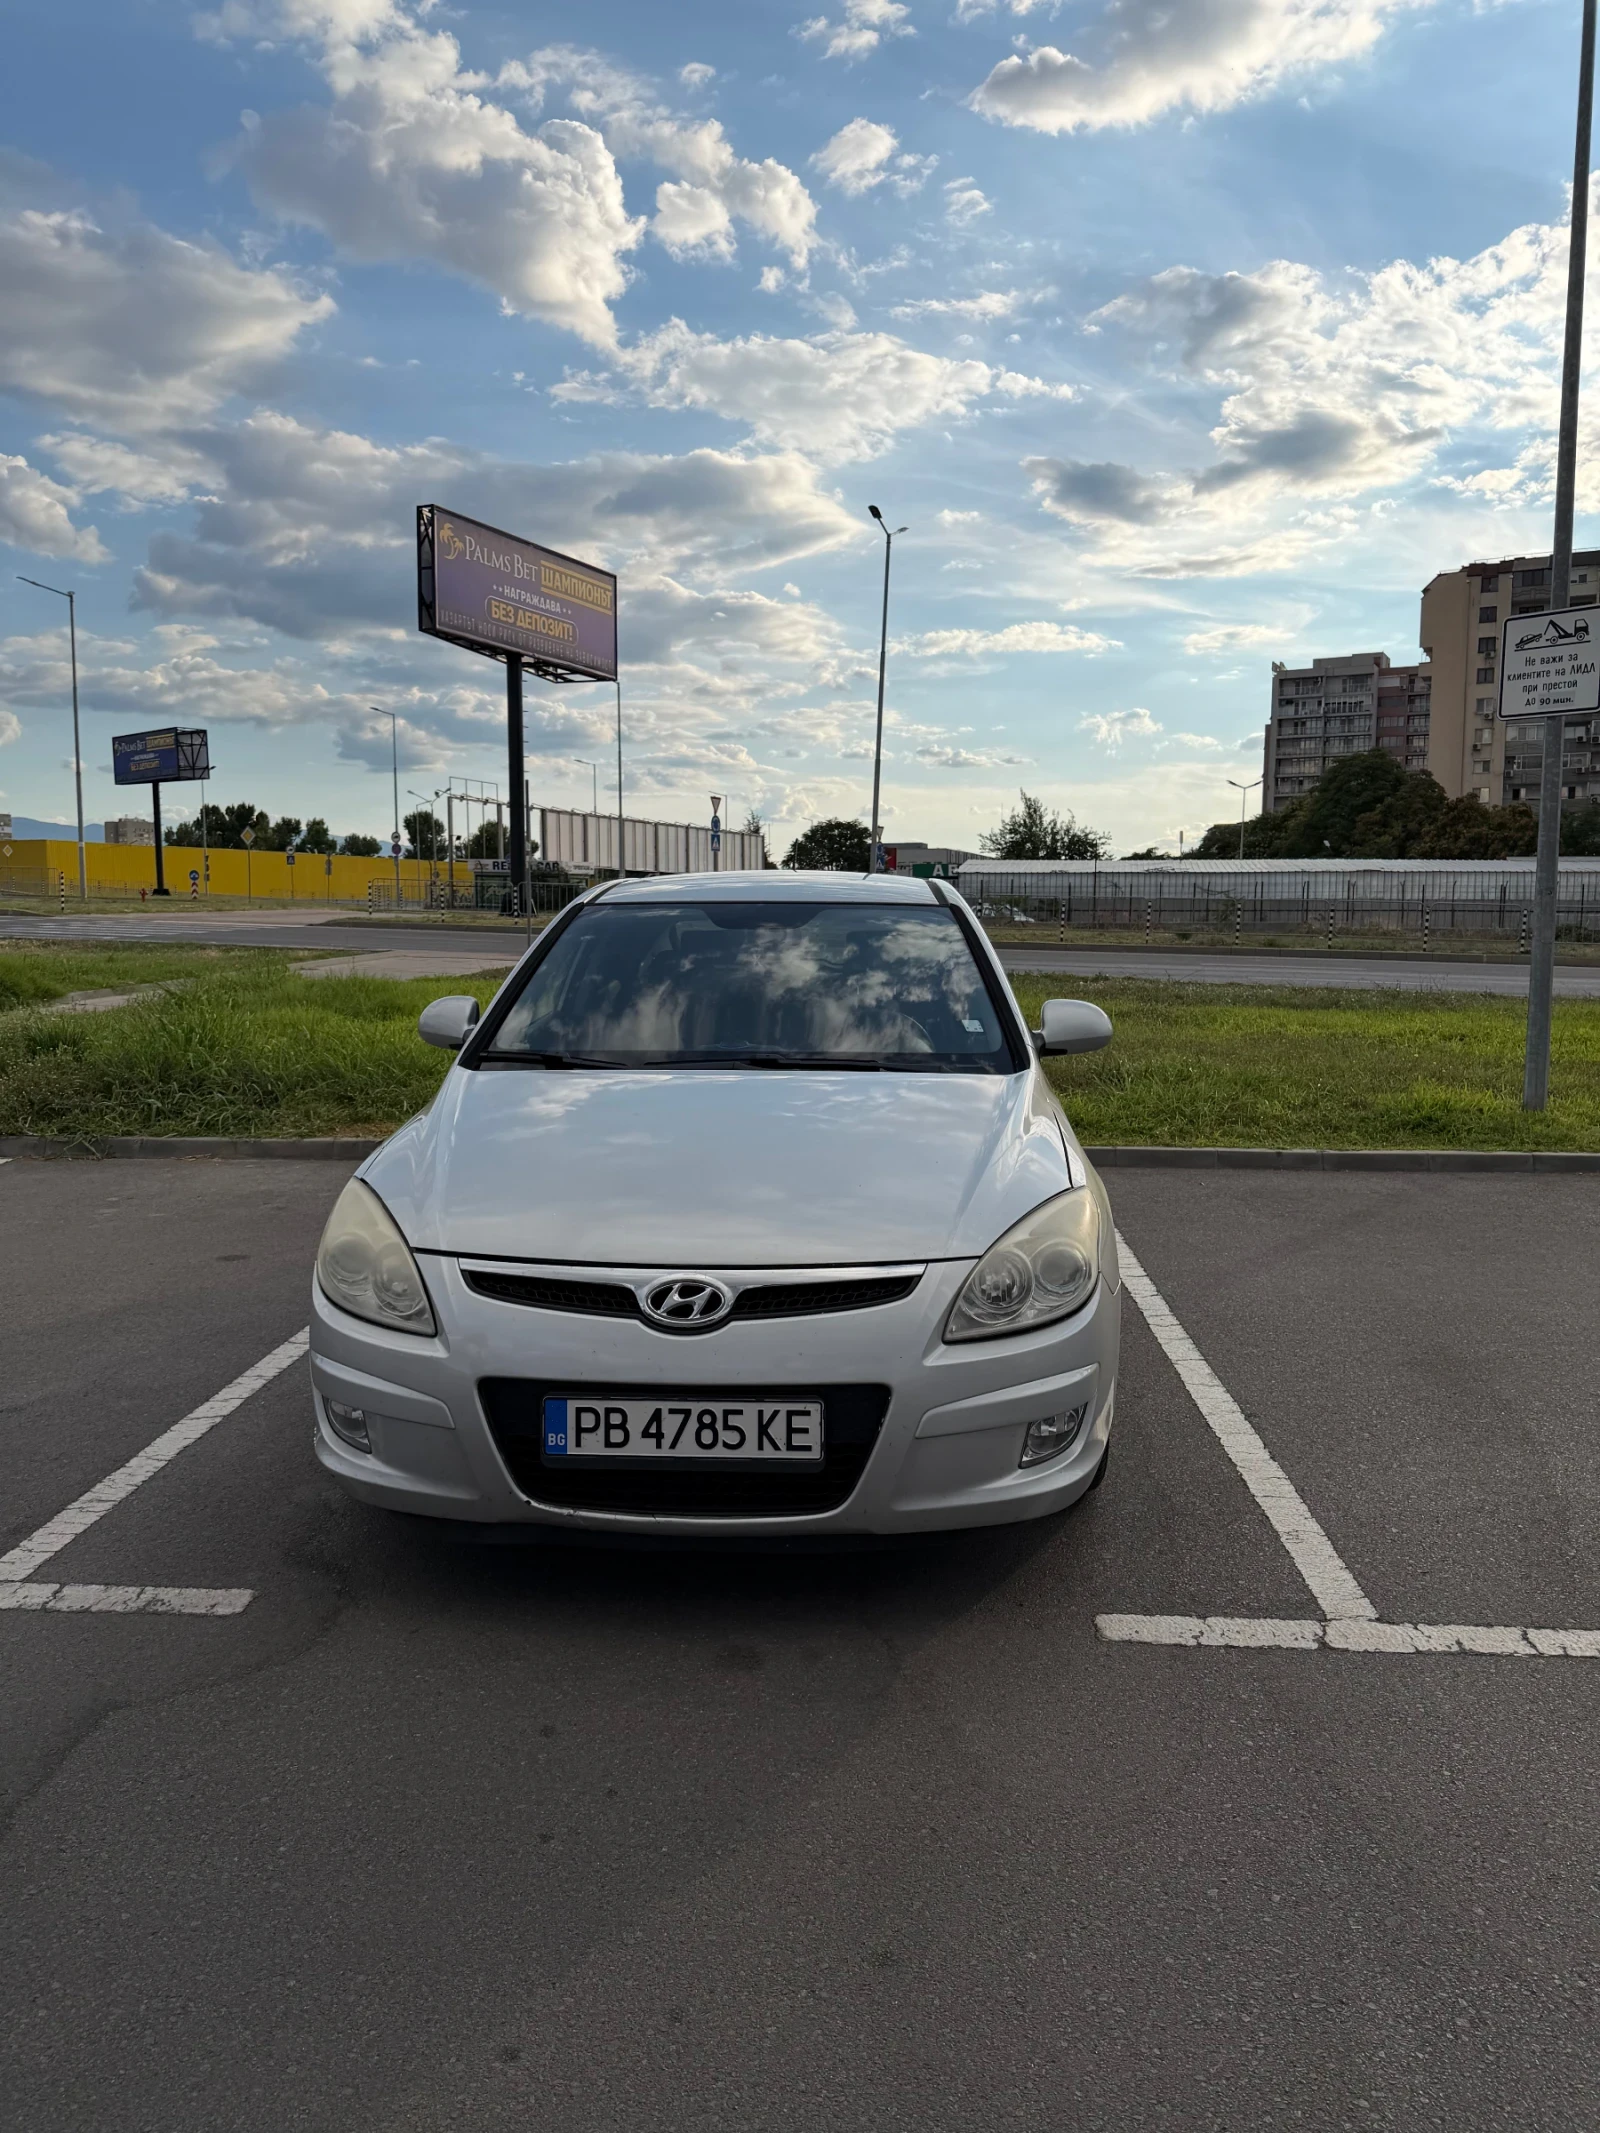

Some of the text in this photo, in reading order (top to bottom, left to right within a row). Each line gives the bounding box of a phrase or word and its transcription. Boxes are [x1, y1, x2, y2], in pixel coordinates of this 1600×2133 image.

[464, 535, 538, 582] PALMS BET
[541, 566, 612, 608] ШАМПИОНЪТ
[504, 585, 561, 613] НАГРАЖДАВА
[491, 600, 573, 641] БЕЗ ДЕПОЗИТ!
[1525, 653, 1578, 667] Не важи за
[1507, 663, 1596, 681] клиентите на ЛИДЛ
[1522, 680, 1577, 694] при престой
[1525, 697, 1536, 706] до
[1539, 697, 1550, 706] 90
[548, 1433, 566, 1446] BG
[574, 1406, 813, 1452] PB 4785 KE
